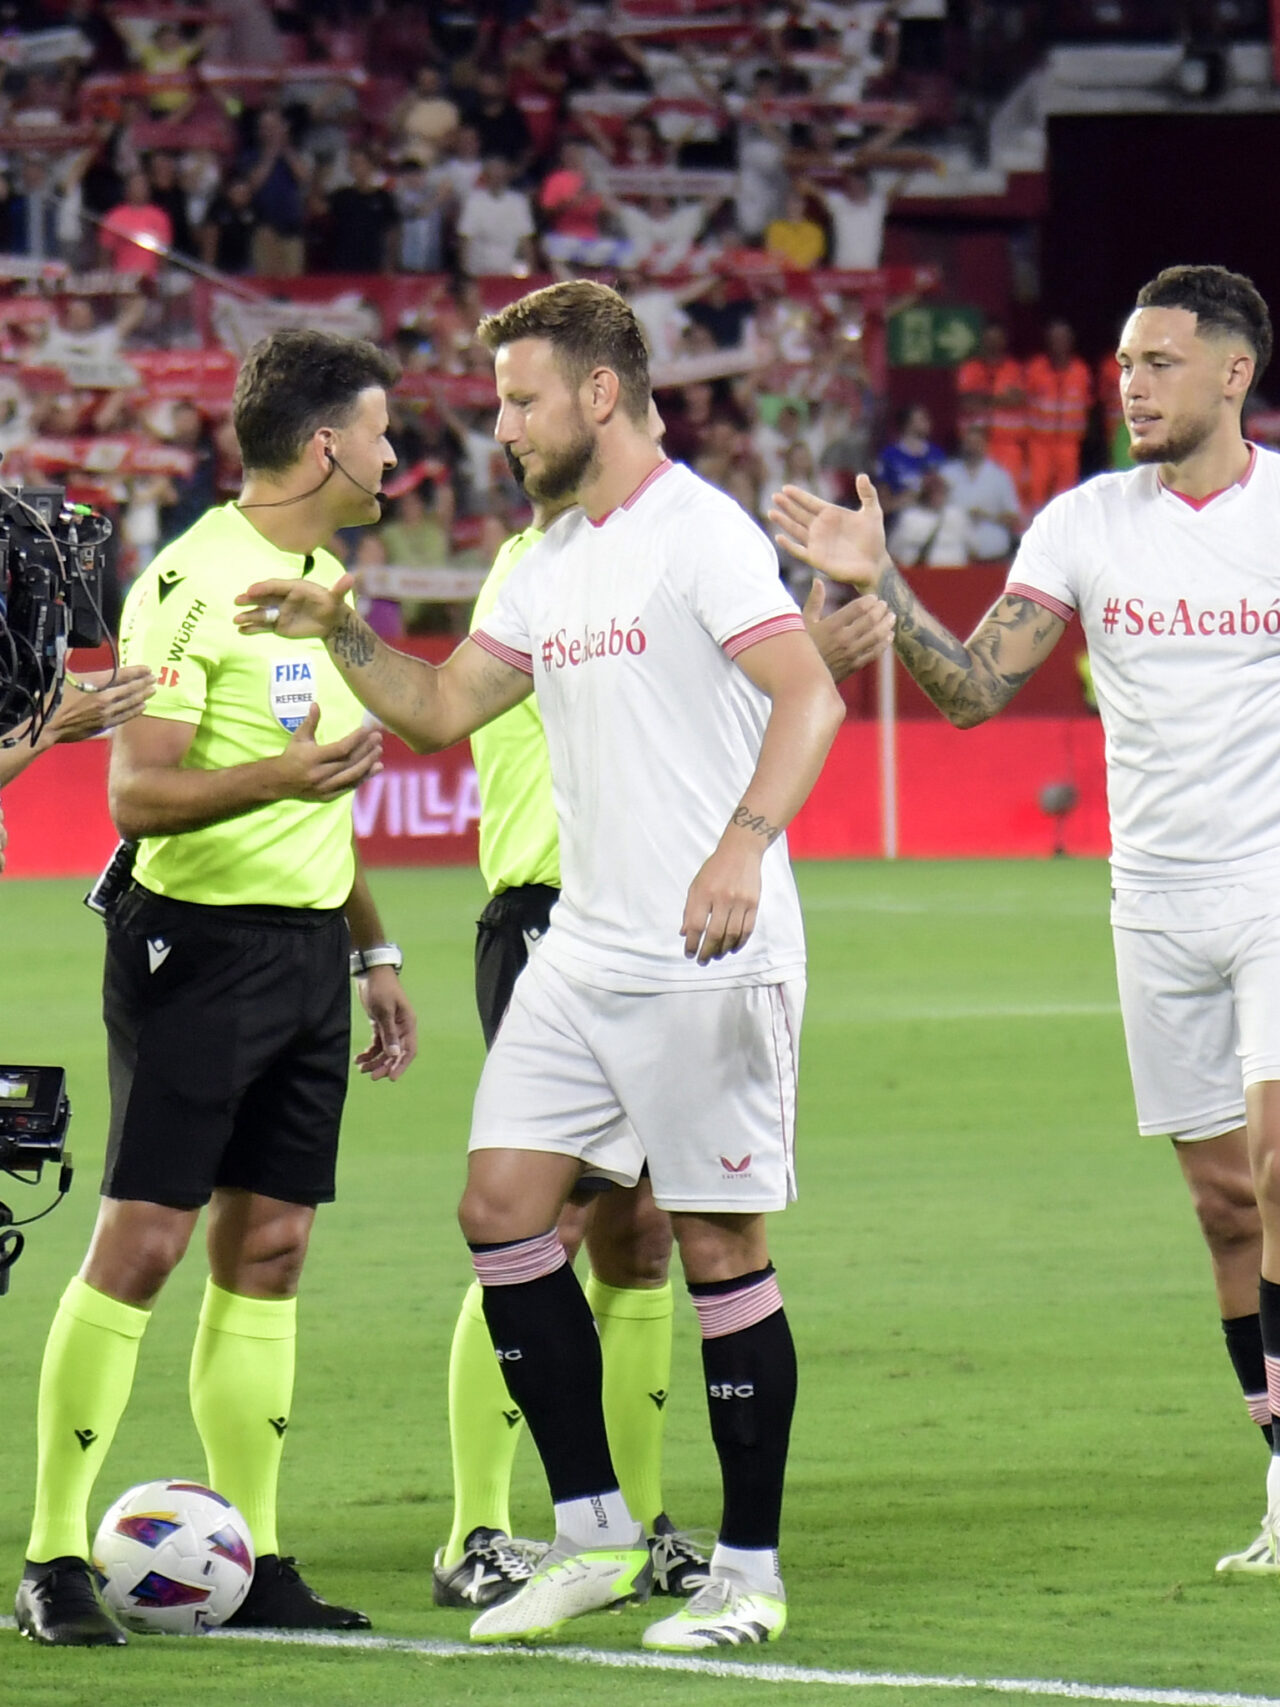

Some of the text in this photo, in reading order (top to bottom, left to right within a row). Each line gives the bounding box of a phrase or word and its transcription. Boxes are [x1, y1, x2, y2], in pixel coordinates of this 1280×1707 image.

[275, 663, 312, 682] FIFA
[275, 693, 313, 704] REFEREE
[710, 1384, 754, 1400] SFC
